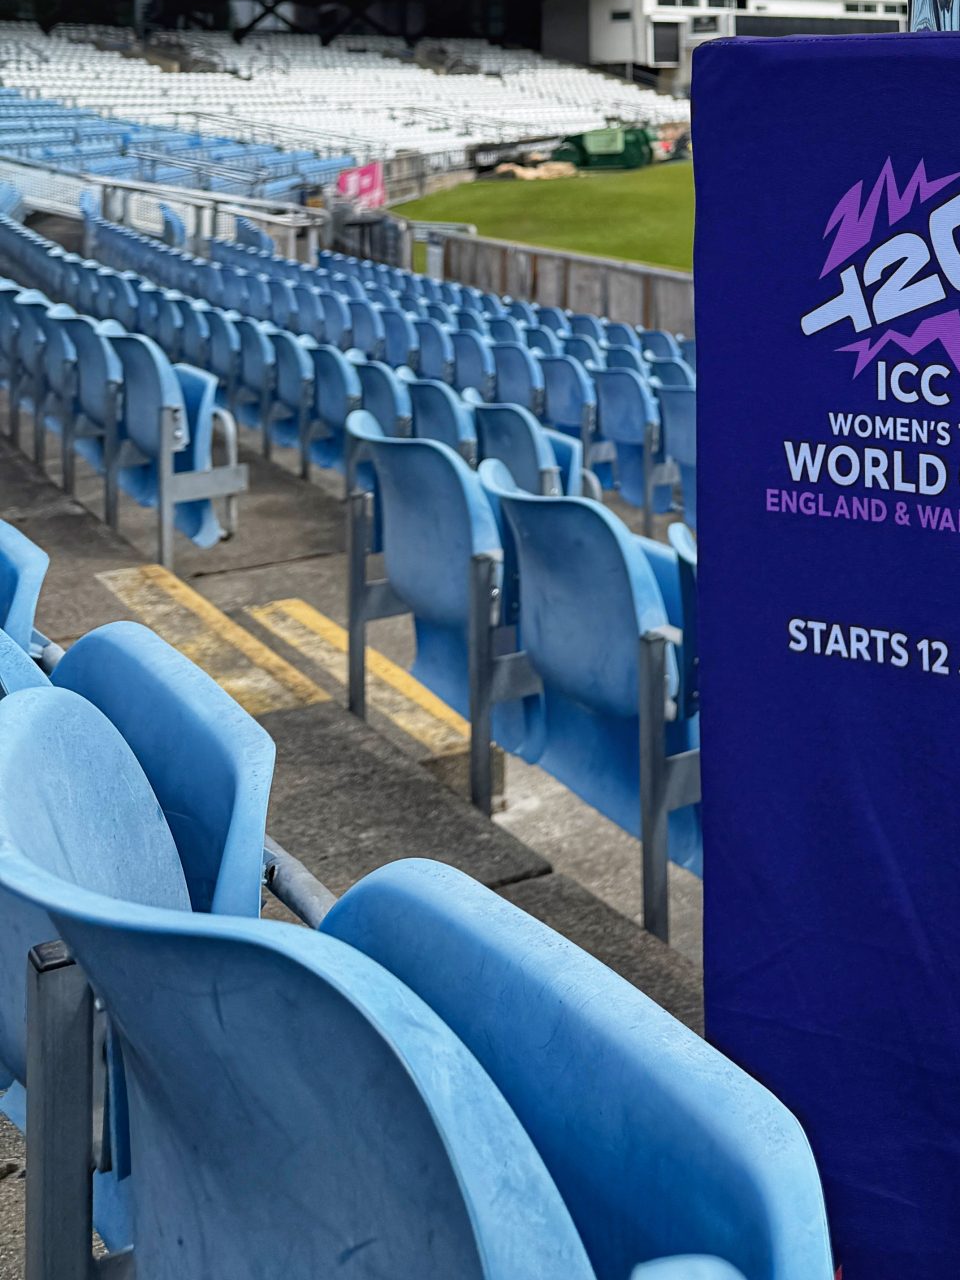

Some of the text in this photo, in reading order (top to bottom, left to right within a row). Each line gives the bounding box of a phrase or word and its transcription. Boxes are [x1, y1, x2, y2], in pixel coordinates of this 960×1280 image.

[877, 361, 950, 406] ICC
[828, 412, 950, 447] WOMEN'S
[783, 441, 947, 497] WORLD
[765, 488, 888, 523] ENGLAND
[894, 504, 911, 527] &
[788, 619, 909, 667] STARTS
[916, 639, 950, 676] 12
